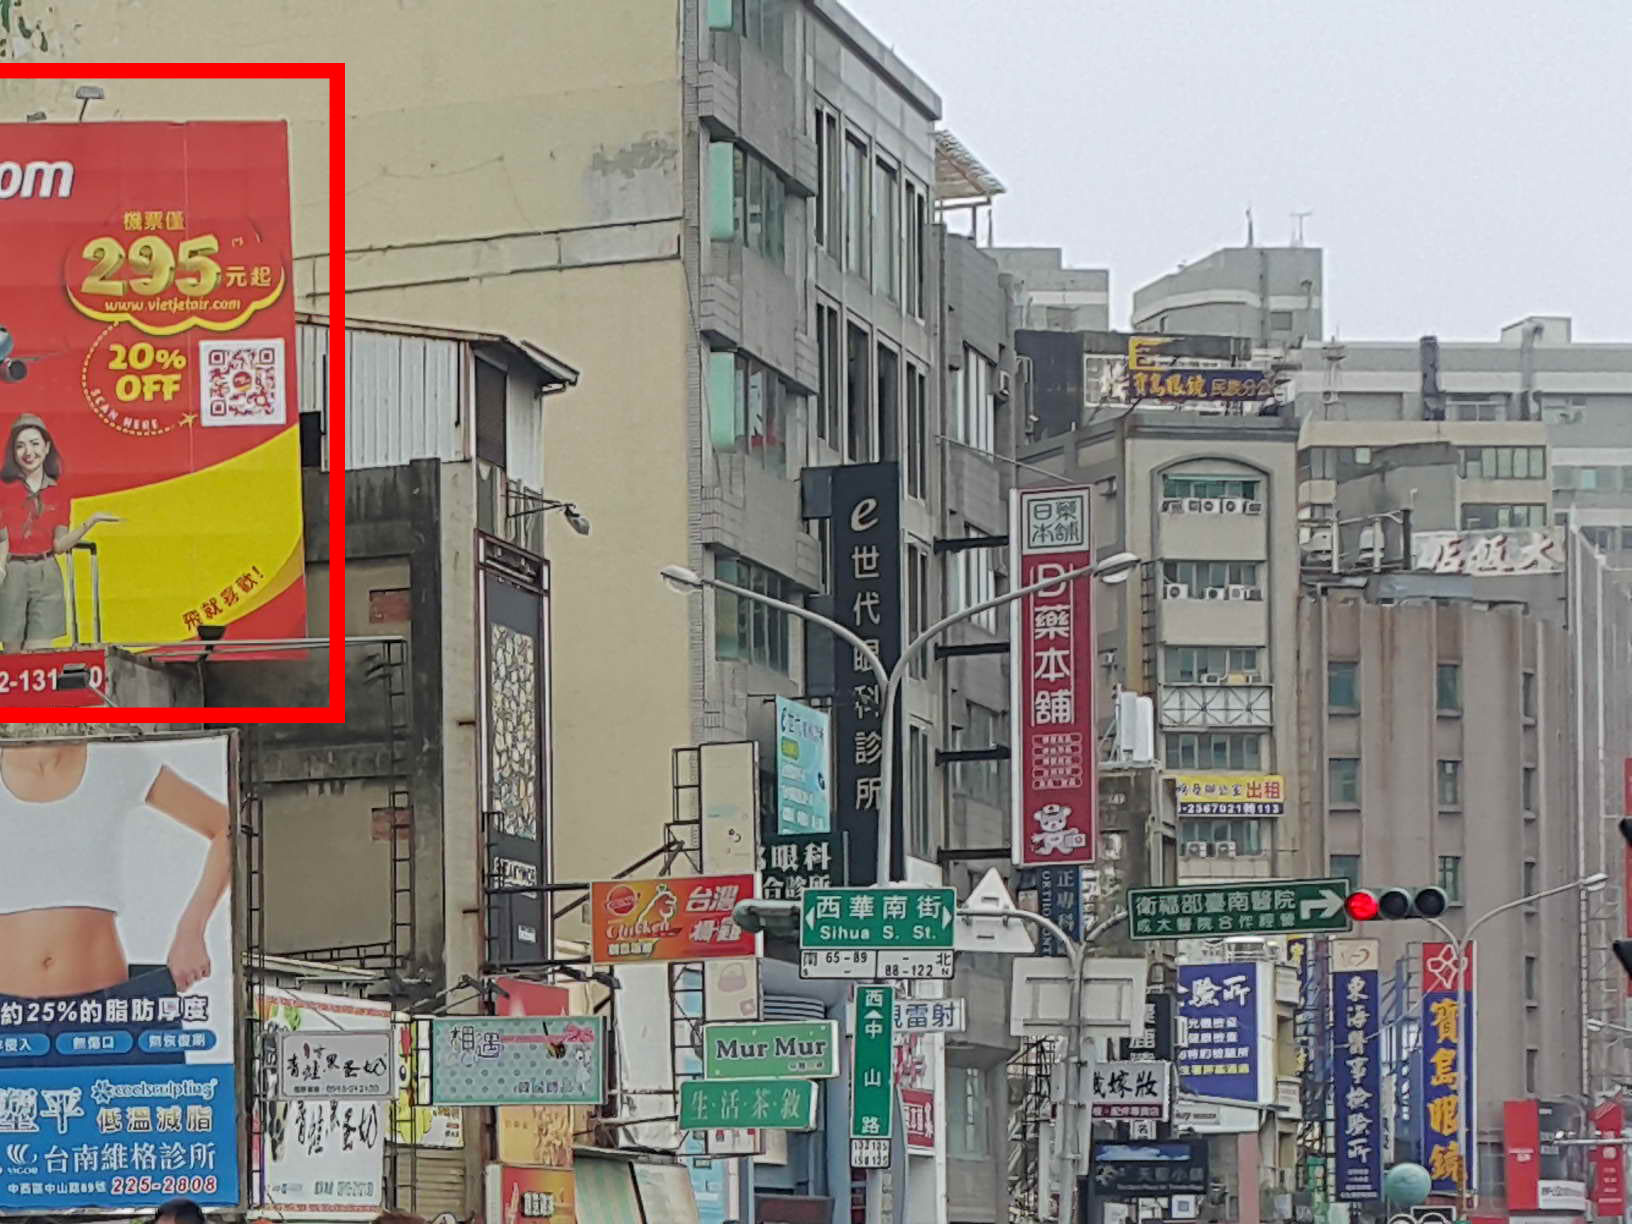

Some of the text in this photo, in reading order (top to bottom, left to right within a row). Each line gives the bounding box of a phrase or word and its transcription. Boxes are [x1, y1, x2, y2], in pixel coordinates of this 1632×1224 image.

[80, 234, 272, 297] 295 元起
[108, 342, 186, 371] 20%
[115, 374, 181, 402] OFF
[760, 842, 832, 872] 眼科
[816, 895, 942, 920] 西華南街
[820, 925, 936, 940] Sihua S. St.
[935, 953, 951, 967] 北
[865, 989, 883, 1008] 西
[716, 1036, 826, 1058] Mur Mur
[860, 1020, 882, 1135] 中山路
[44, 1142, 216, 1173] 台南維格診所
[111, 1176, 217, 1194] 225-2808
